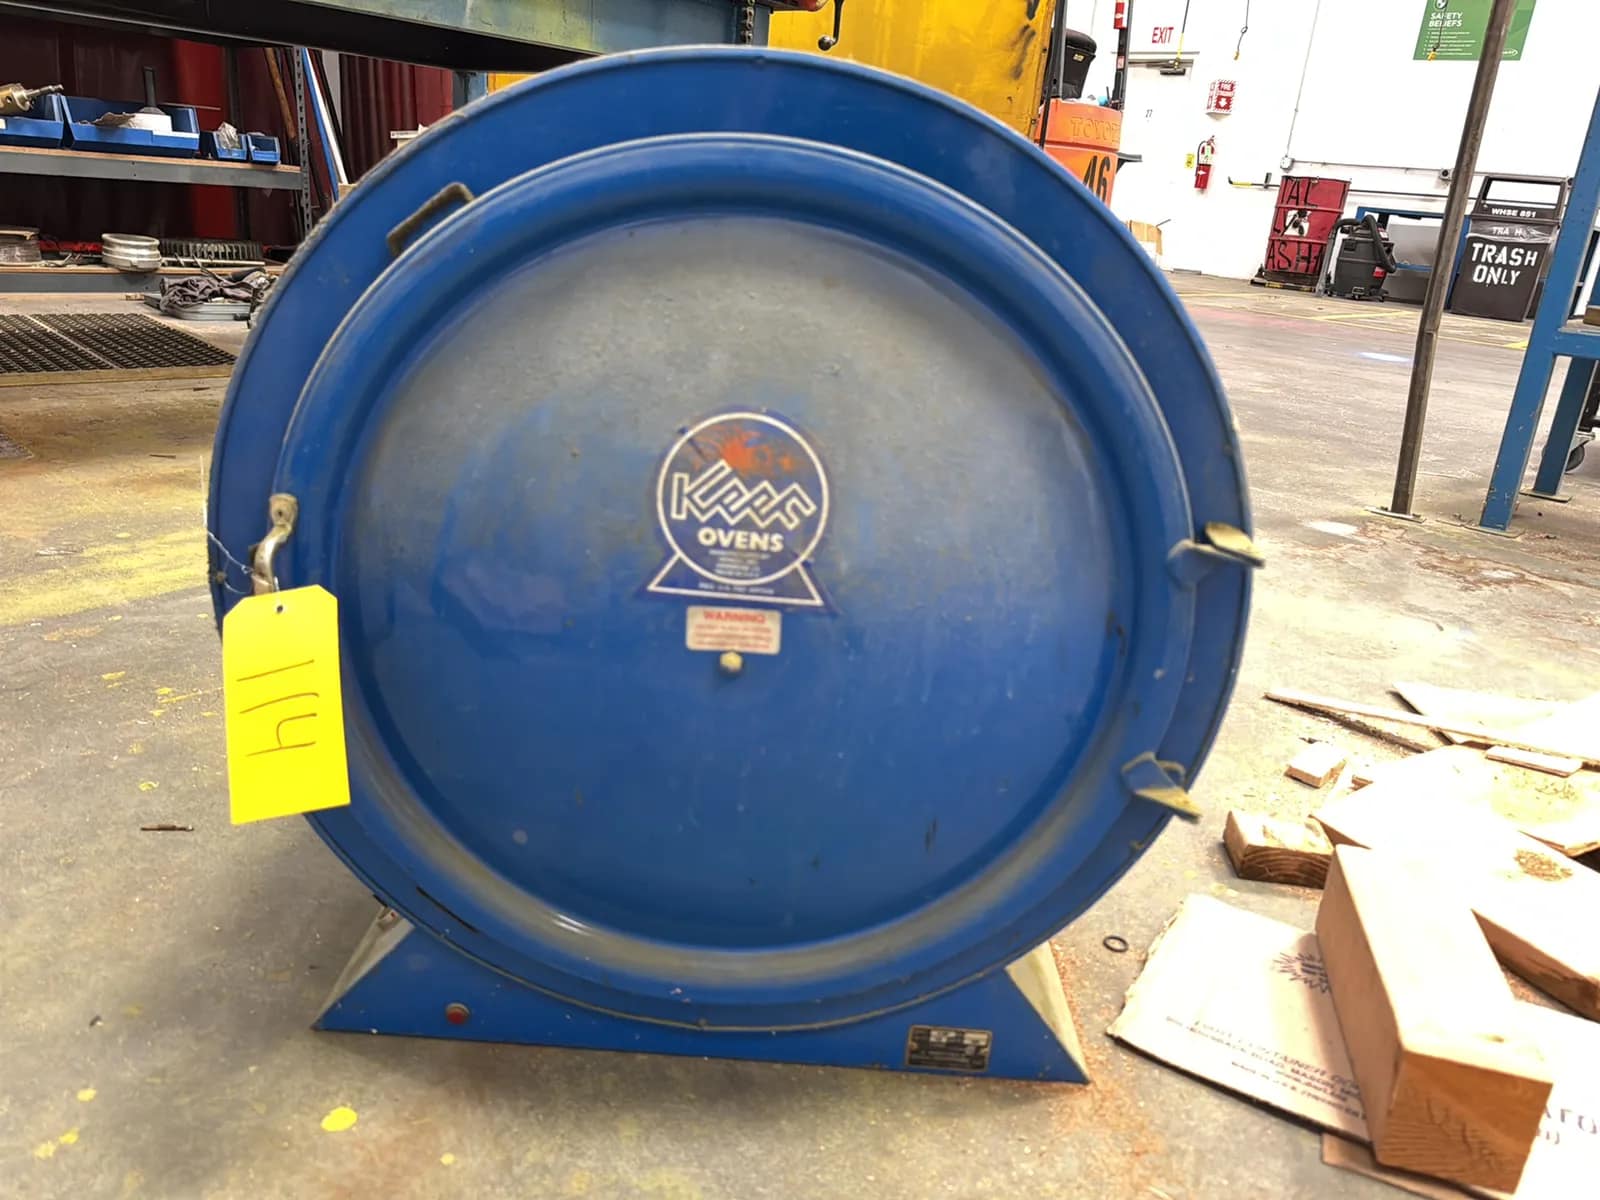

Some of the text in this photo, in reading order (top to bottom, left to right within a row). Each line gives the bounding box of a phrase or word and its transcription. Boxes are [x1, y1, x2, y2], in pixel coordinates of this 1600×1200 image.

[1428, 20, 1463, 28] BELIEFS
[1430, 12, 1463, 20] SAFETY
[1151, 27, 1174, 44] EXIT
[1492, 226, 1523, 236] TRAH
[1471, 242, 1538, 267] TRASH
[1472, 264, 1521, 286] ONLY
[697, 526, 785, 552] OVENS
